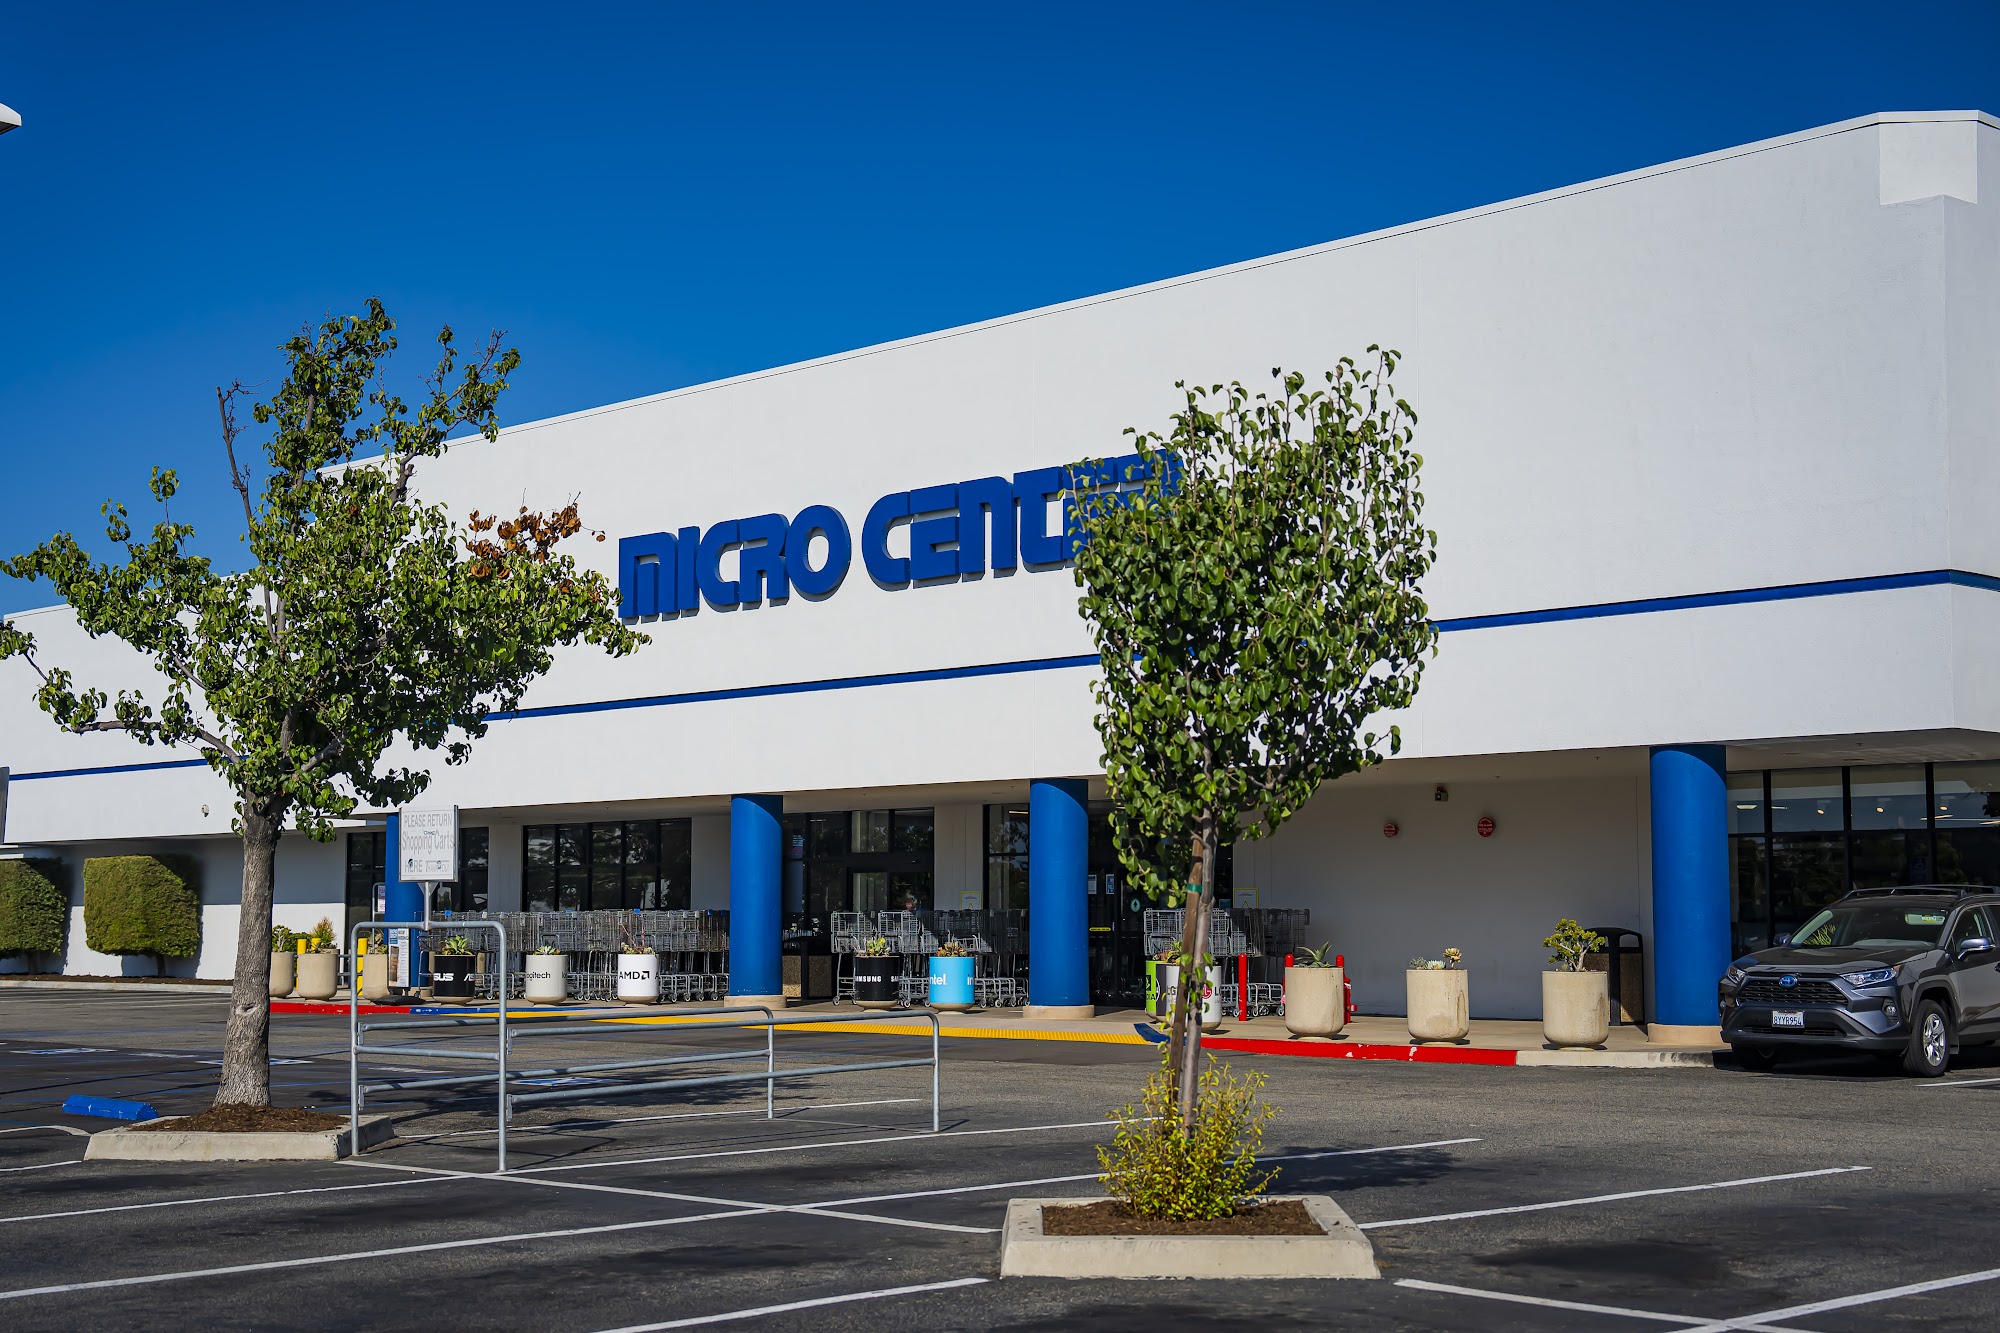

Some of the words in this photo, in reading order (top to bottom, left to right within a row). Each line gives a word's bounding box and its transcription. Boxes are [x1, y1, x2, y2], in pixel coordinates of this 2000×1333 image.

[618, 504, 852, 619] MICRO
[404, 814, 426, 827] PLEASE
[427, 813, 453, 826] RETURN
[402, 830, 433, 855] Shopping
[434, 829, 455, 850] Carts
[619, 971, 640, 980] AMD
